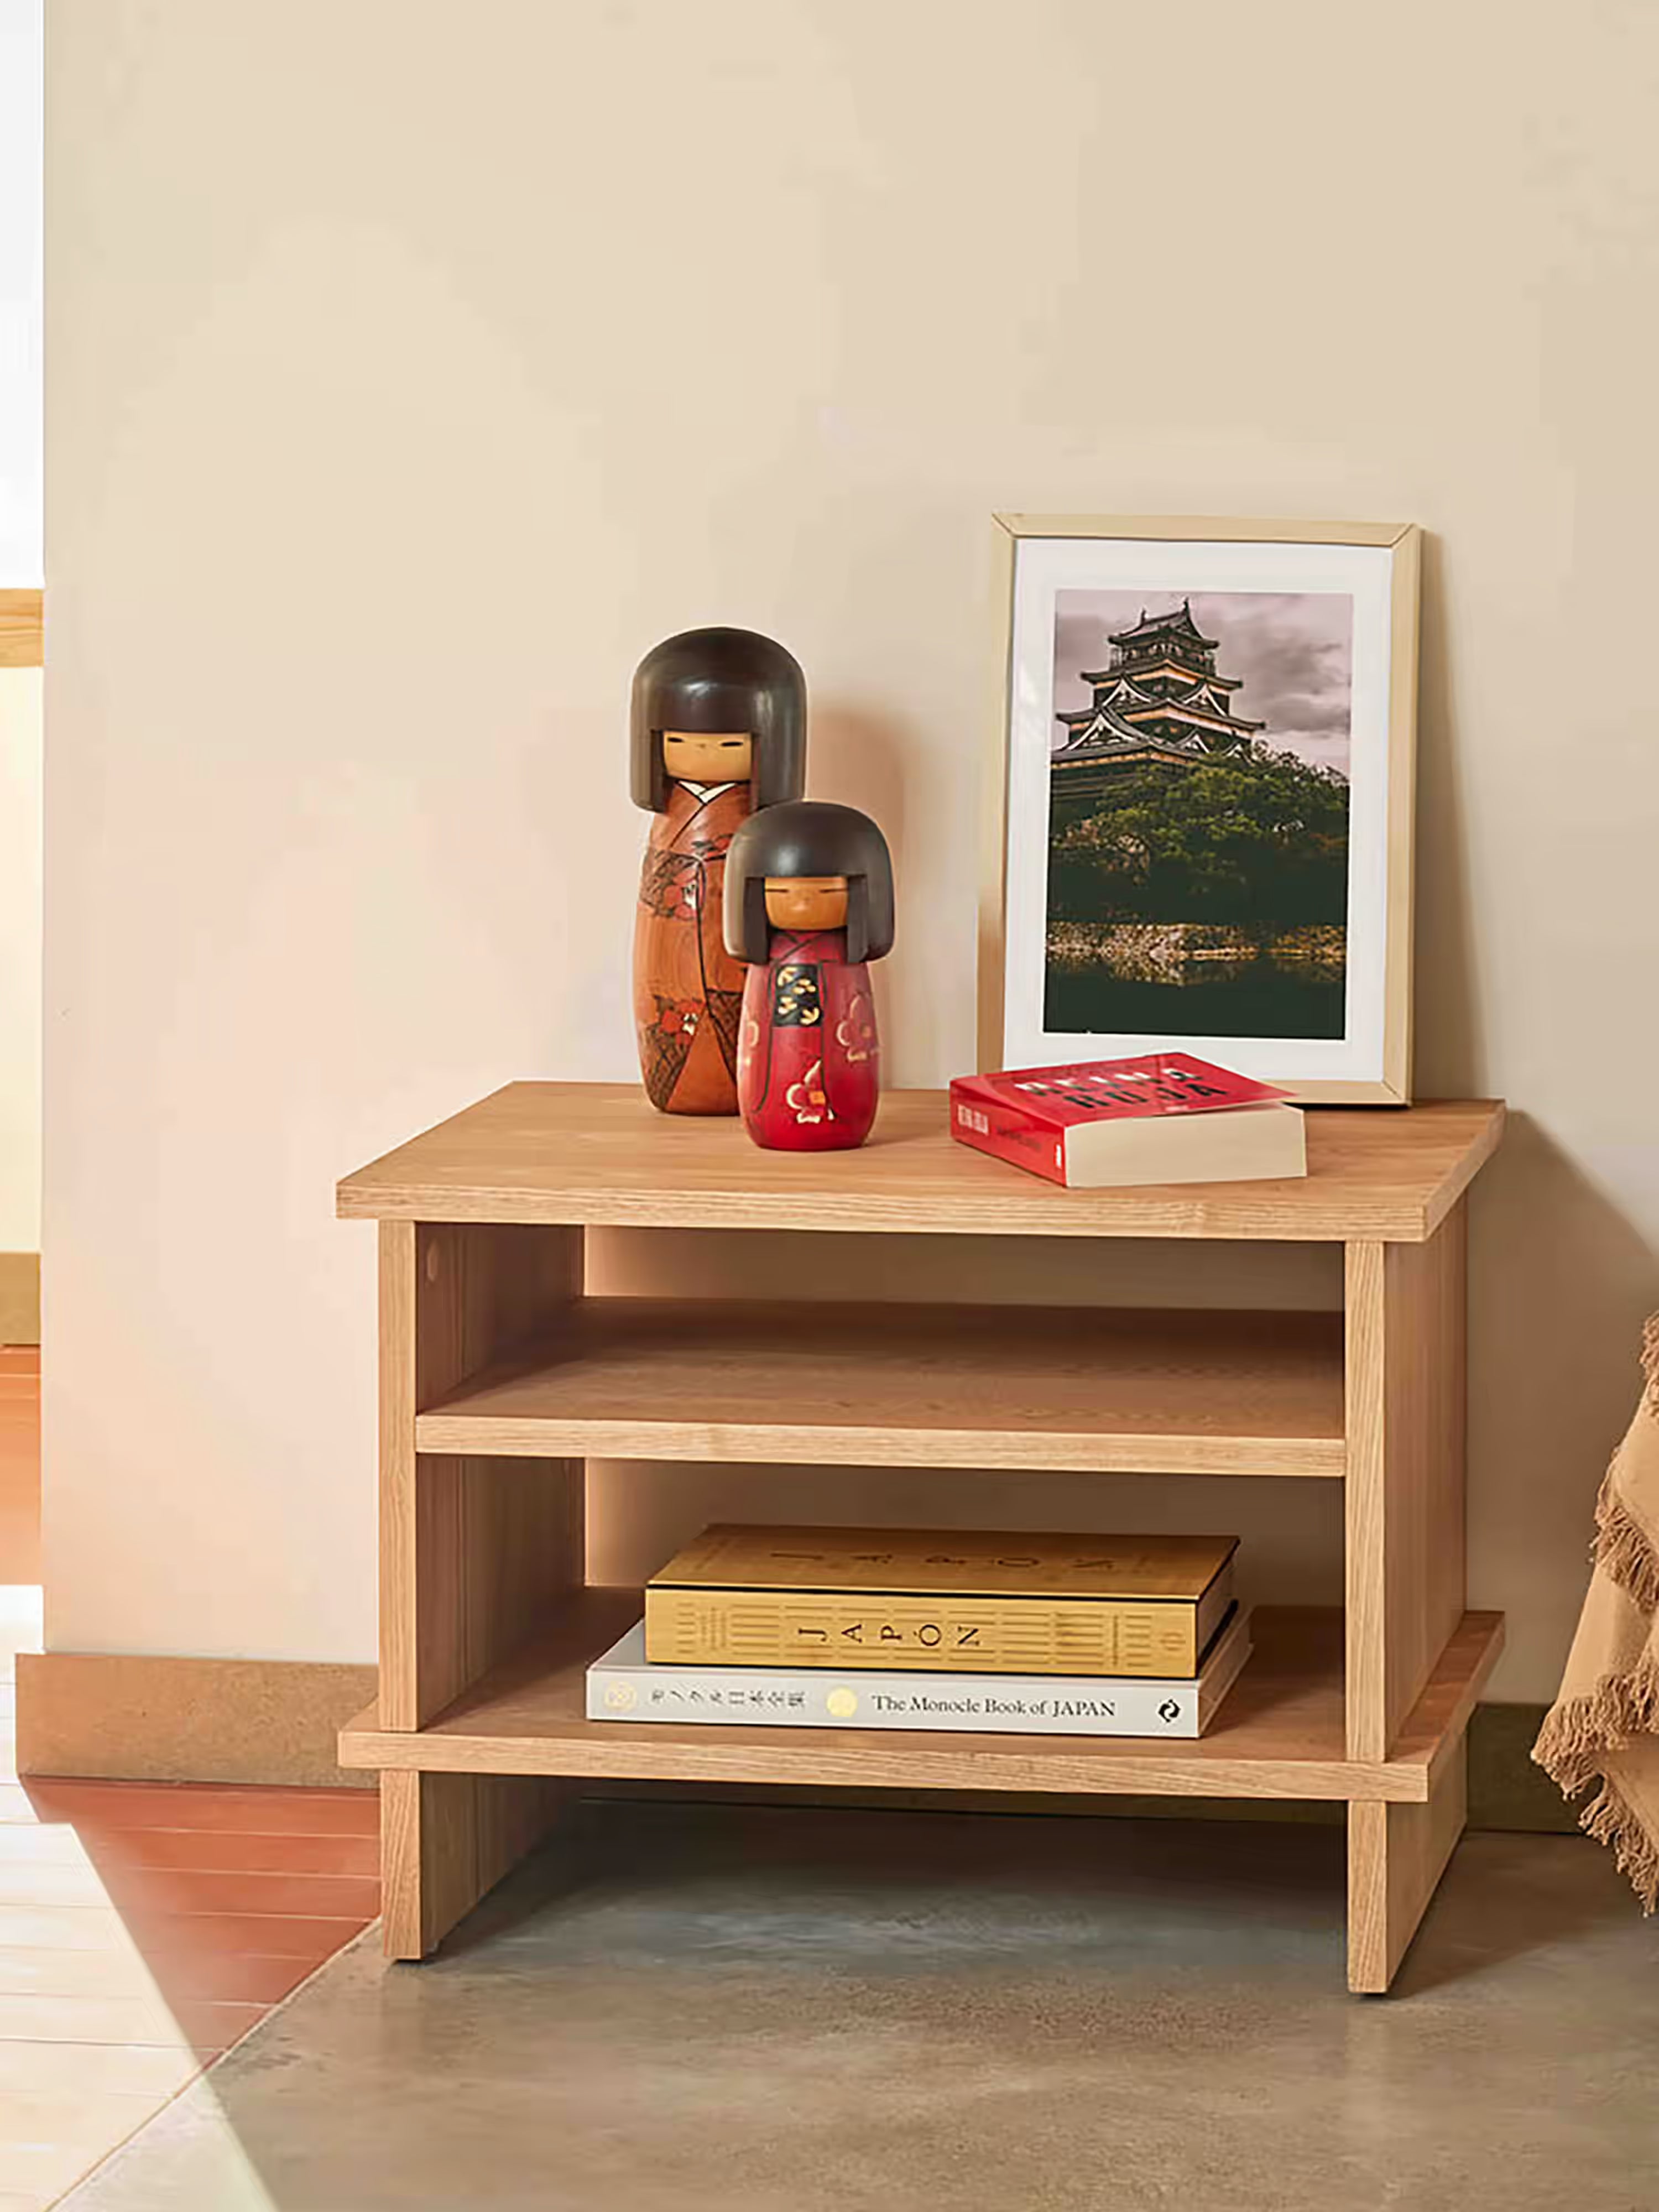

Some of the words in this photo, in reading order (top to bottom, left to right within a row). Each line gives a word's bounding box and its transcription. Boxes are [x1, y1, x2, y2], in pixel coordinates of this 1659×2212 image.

[872, 1695, 906, 1711] The
[910, 1696, 981, 1713] Monocle
[985, 1698, 1026, 1714] Book
[1029, 1699, 1048, 1715] of
[1052, 1700, 1115, 1718] JAPAN
